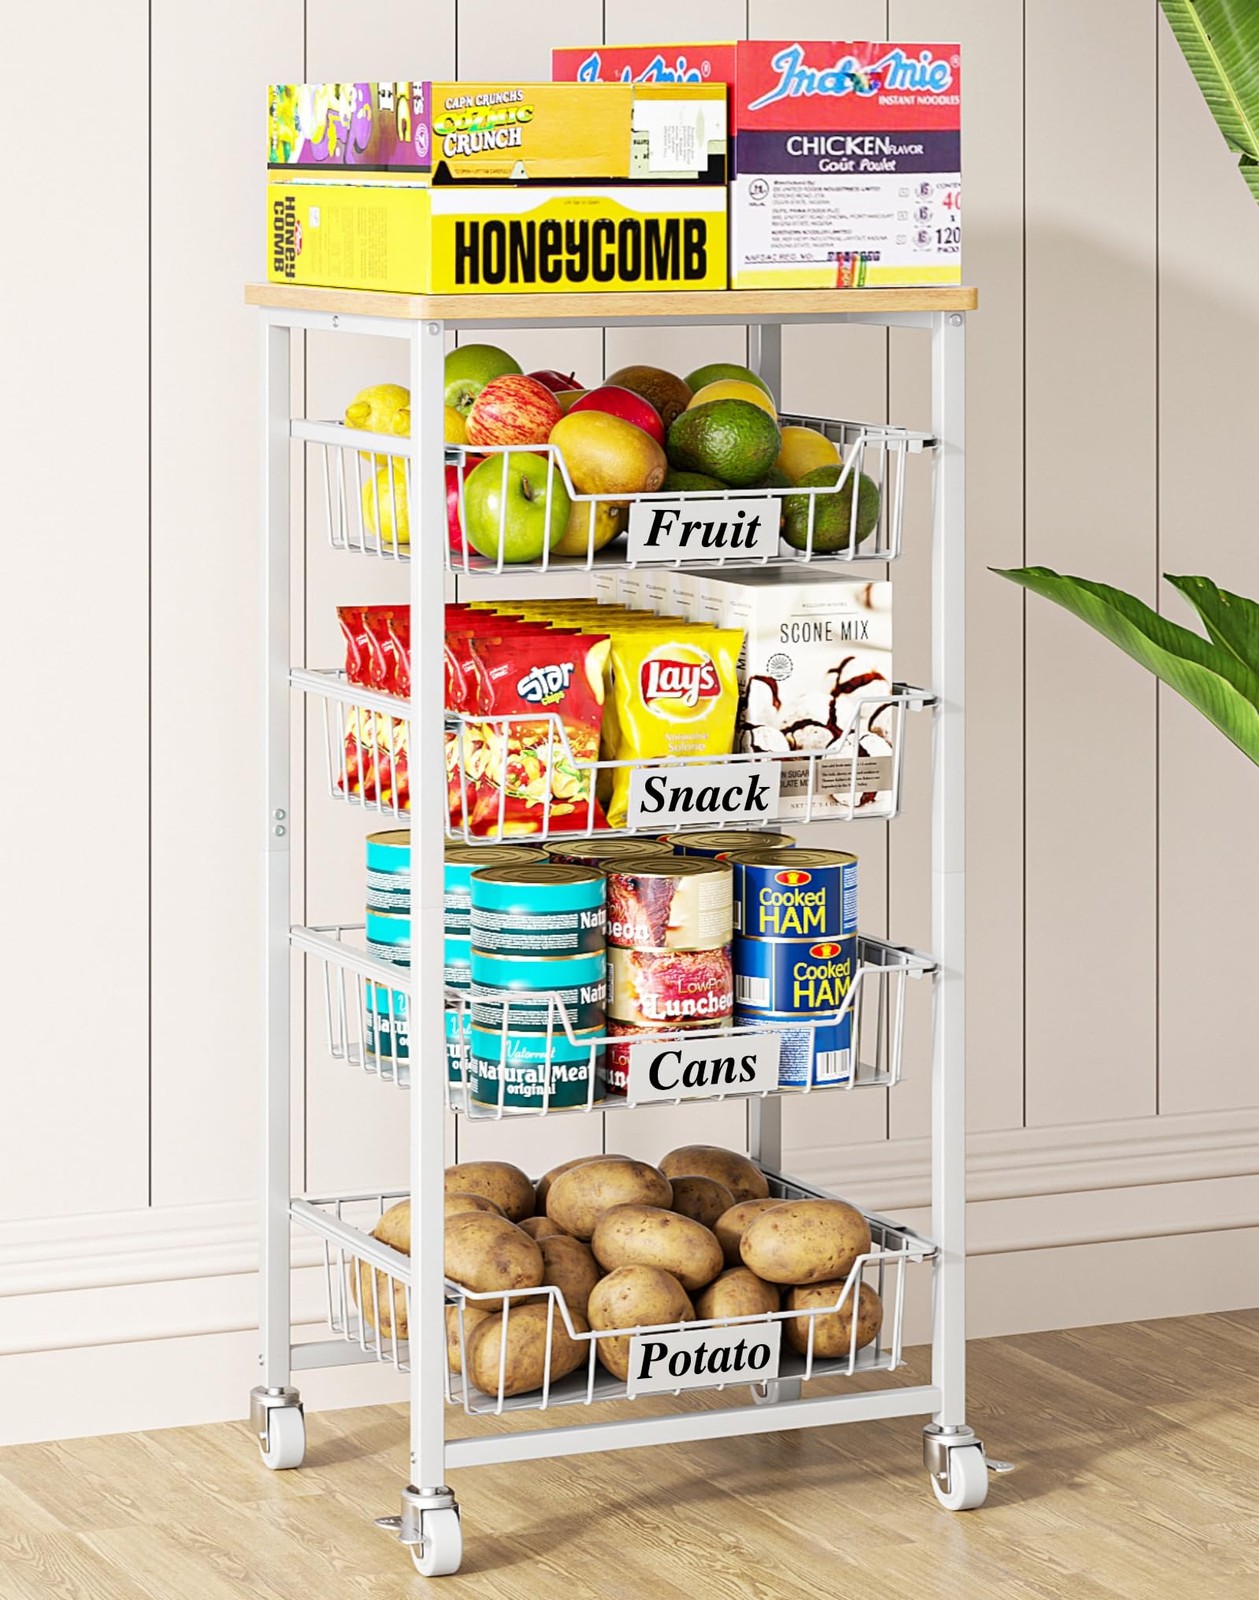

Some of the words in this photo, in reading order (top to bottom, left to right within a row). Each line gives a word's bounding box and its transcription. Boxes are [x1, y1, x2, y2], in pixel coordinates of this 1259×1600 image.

[878, 95, 915, 105] INSTANT
[917, 95, 960, 105] NOODLES
[443, 127, 522, 158] CRUNCH
[786, 136, 889, 155] CHICKEN
[888, 145, 924, 155] FLAVOR
[859, 157, 896, 171] Poulet
[274, 201, 284, 272] COMB
[935, 227, 961, 244] 120
[643, 509, 762, 549] Fruit
[780, 621, 833, 644] SCONE
[841, 619, 869, 641] MIX
[640, 774, 770, 813] Snack
[759, 887, 826, 907] Cooked
[759, 905, 826, 934] HAM
[793, 957, 851, 981] Cooked
[793, 975, 851, 1008] HAM
[649, 1049, 757, 1091] Cans
[636, 1338, 771, 1380] Potato
